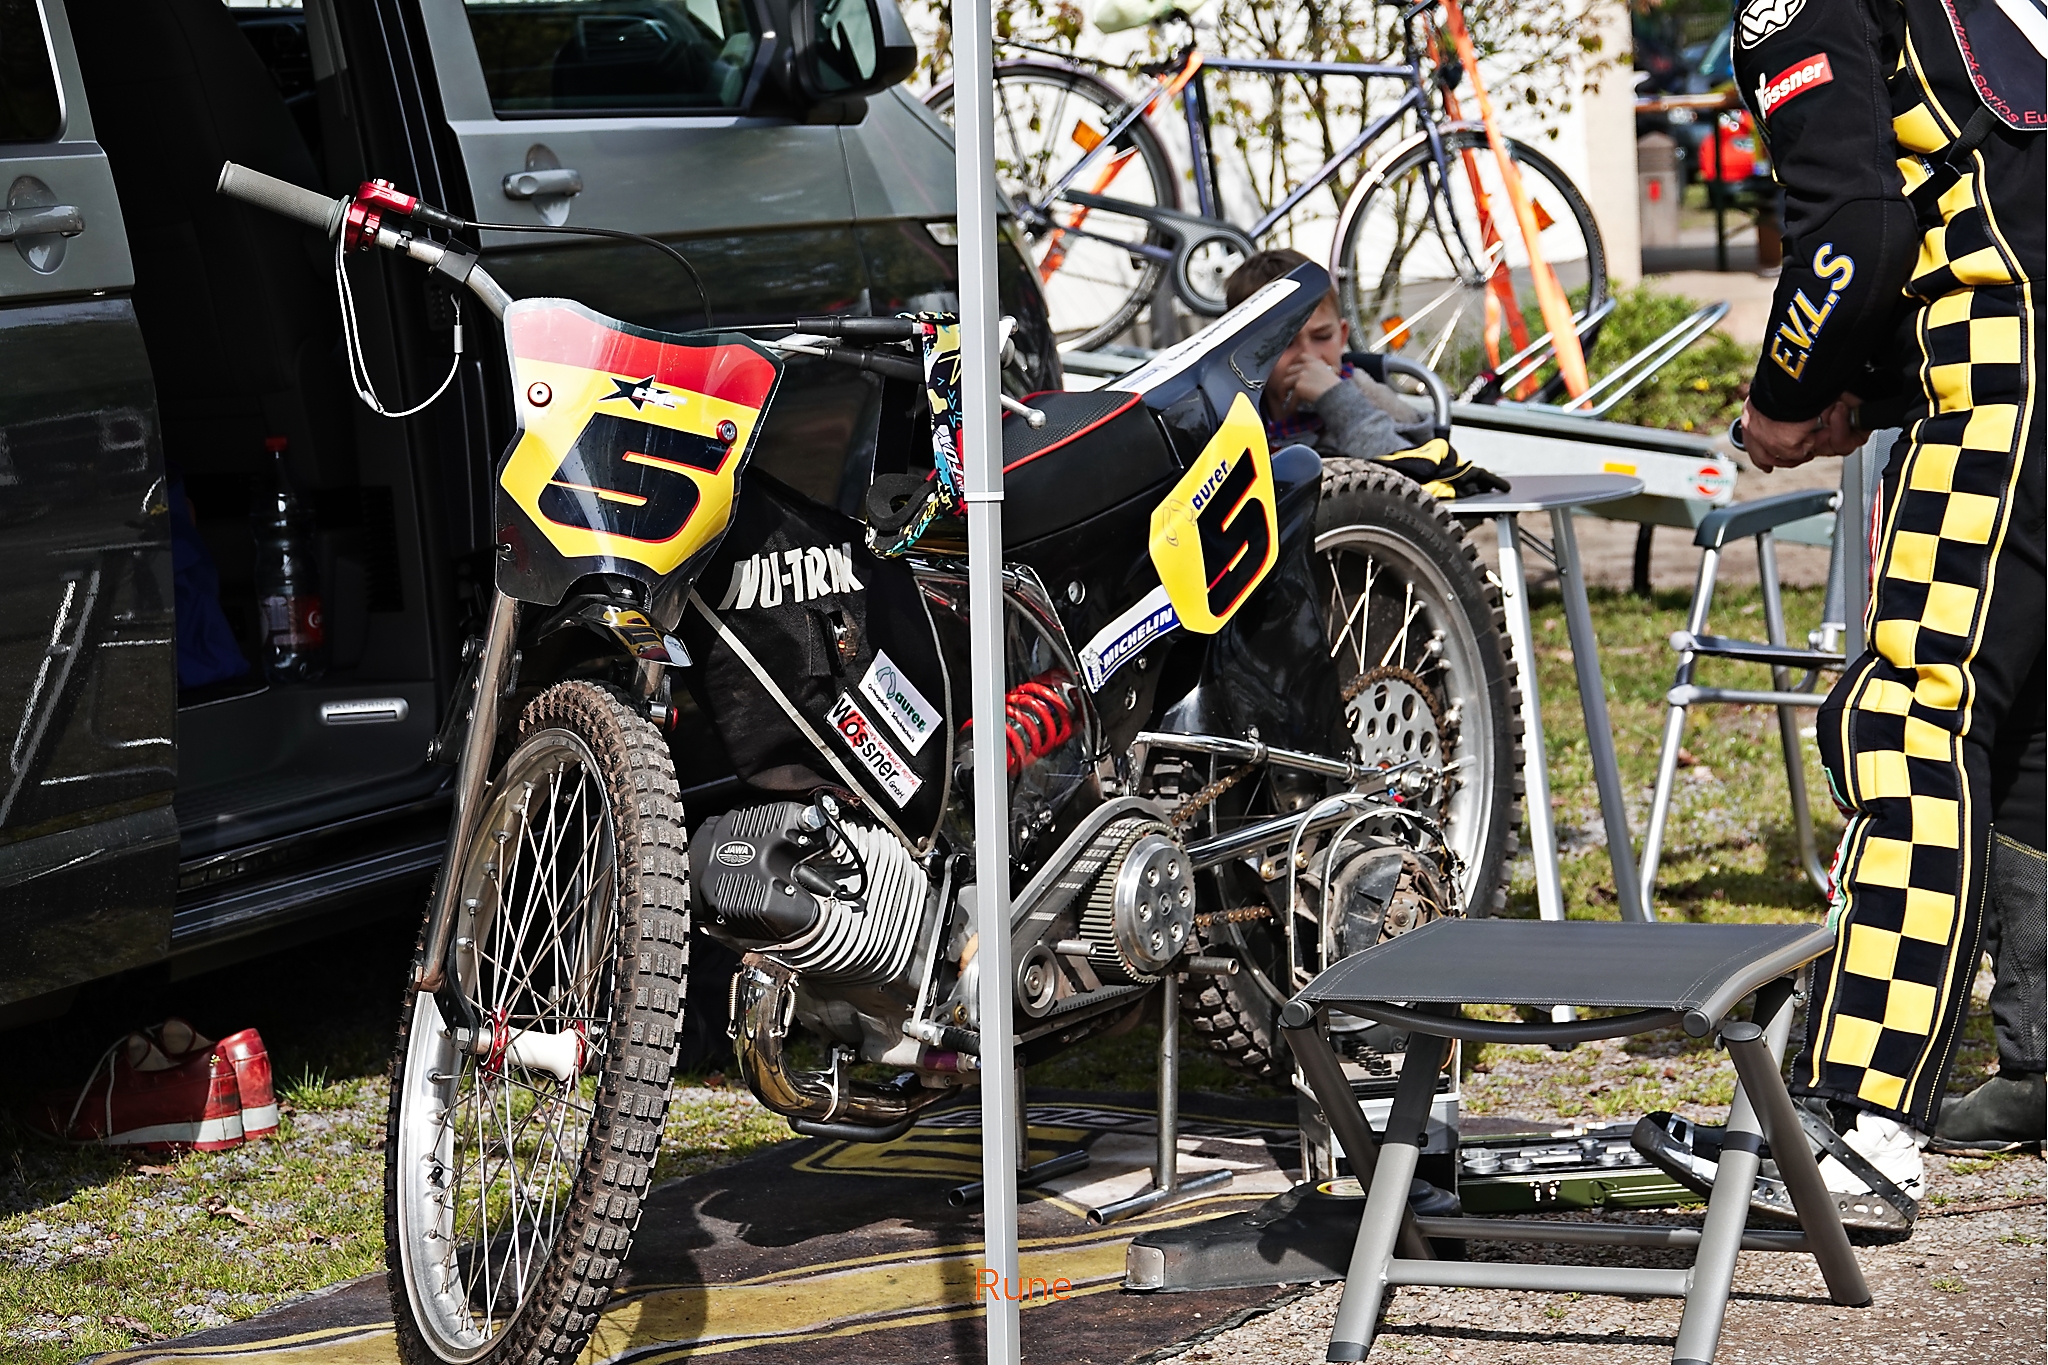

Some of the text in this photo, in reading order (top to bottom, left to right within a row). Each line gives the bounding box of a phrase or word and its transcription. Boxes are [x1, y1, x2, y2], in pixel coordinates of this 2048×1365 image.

[538, 412, 733, 544] 5
[1196, 447, 1270, 618] 5
[1103, 607, 1173, 669] MICHELIN
[833, 698, 906, 799] Wössner GmbH
[724, 845, 749, 855] JAWA
